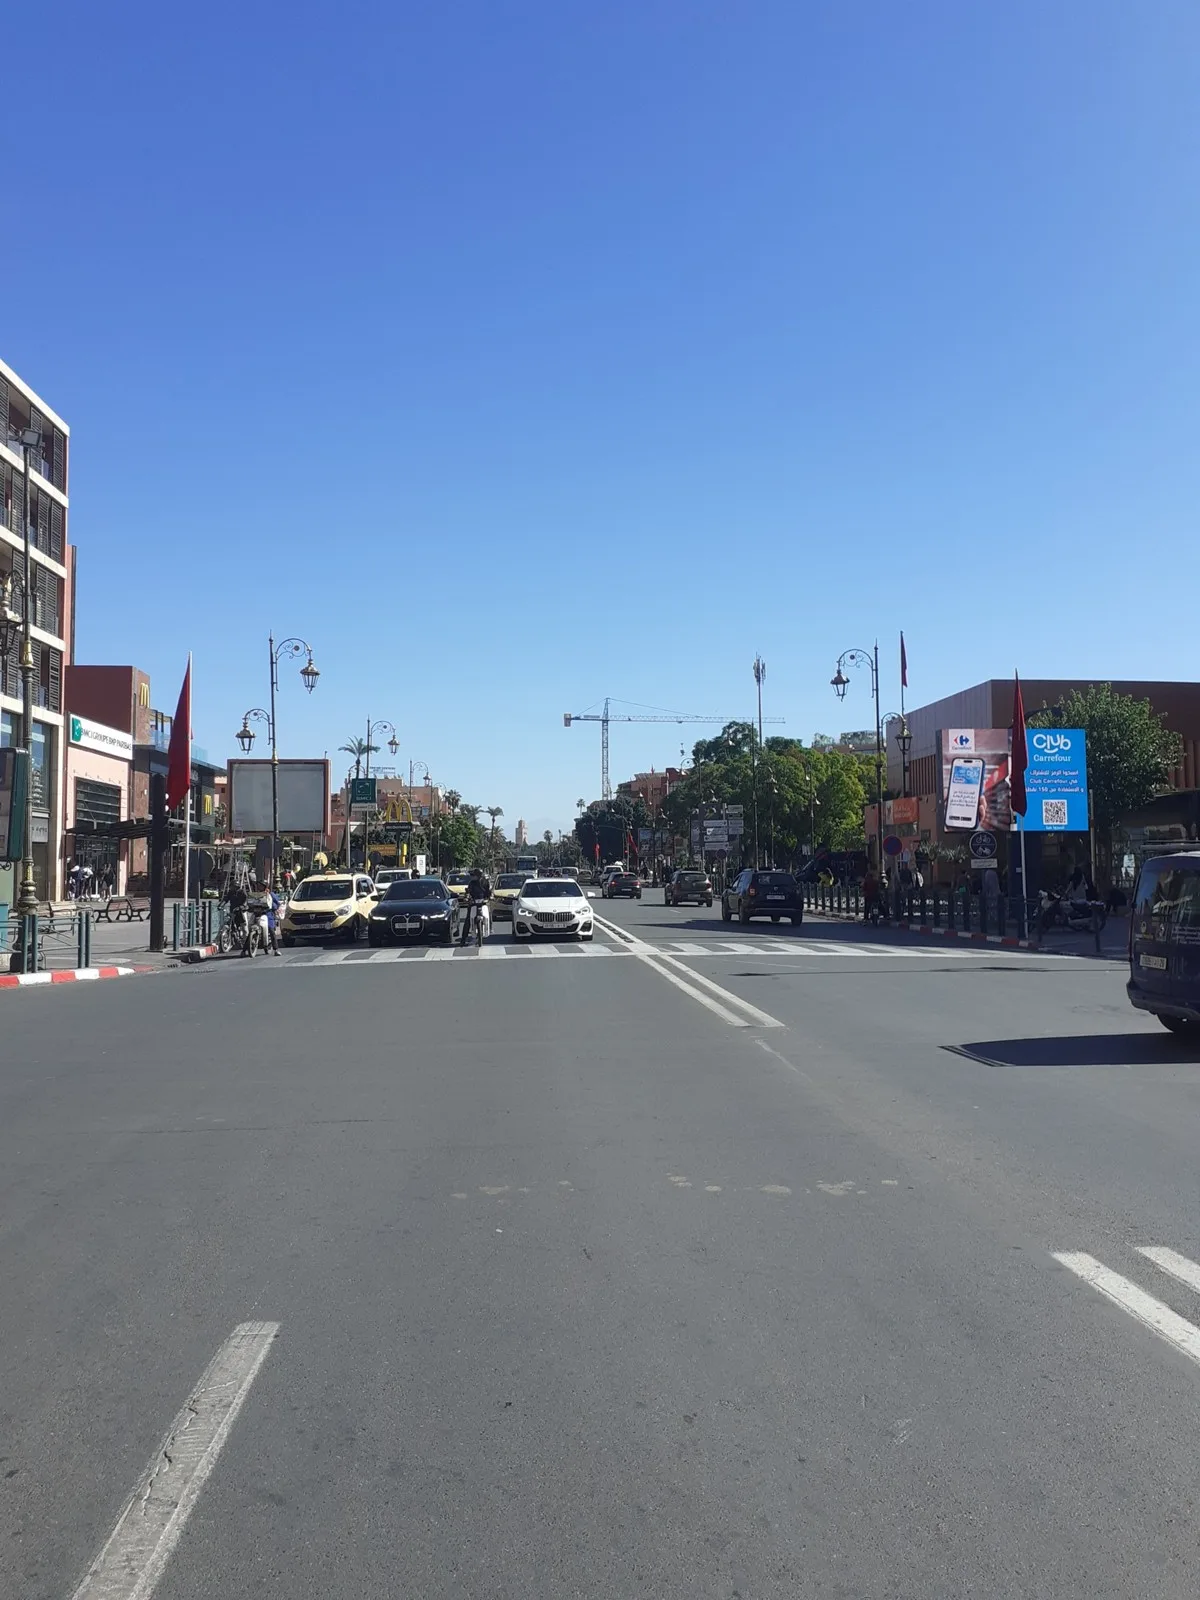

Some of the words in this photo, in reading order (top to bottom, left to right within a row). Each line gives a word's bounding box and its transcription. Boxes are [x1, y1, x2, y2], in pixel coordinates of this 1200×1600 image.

[93, 731, 108, 745] GROUPE
[1033, 734, 1071, 752] Club
[1033, 754, 1072, 762] Carrefour
